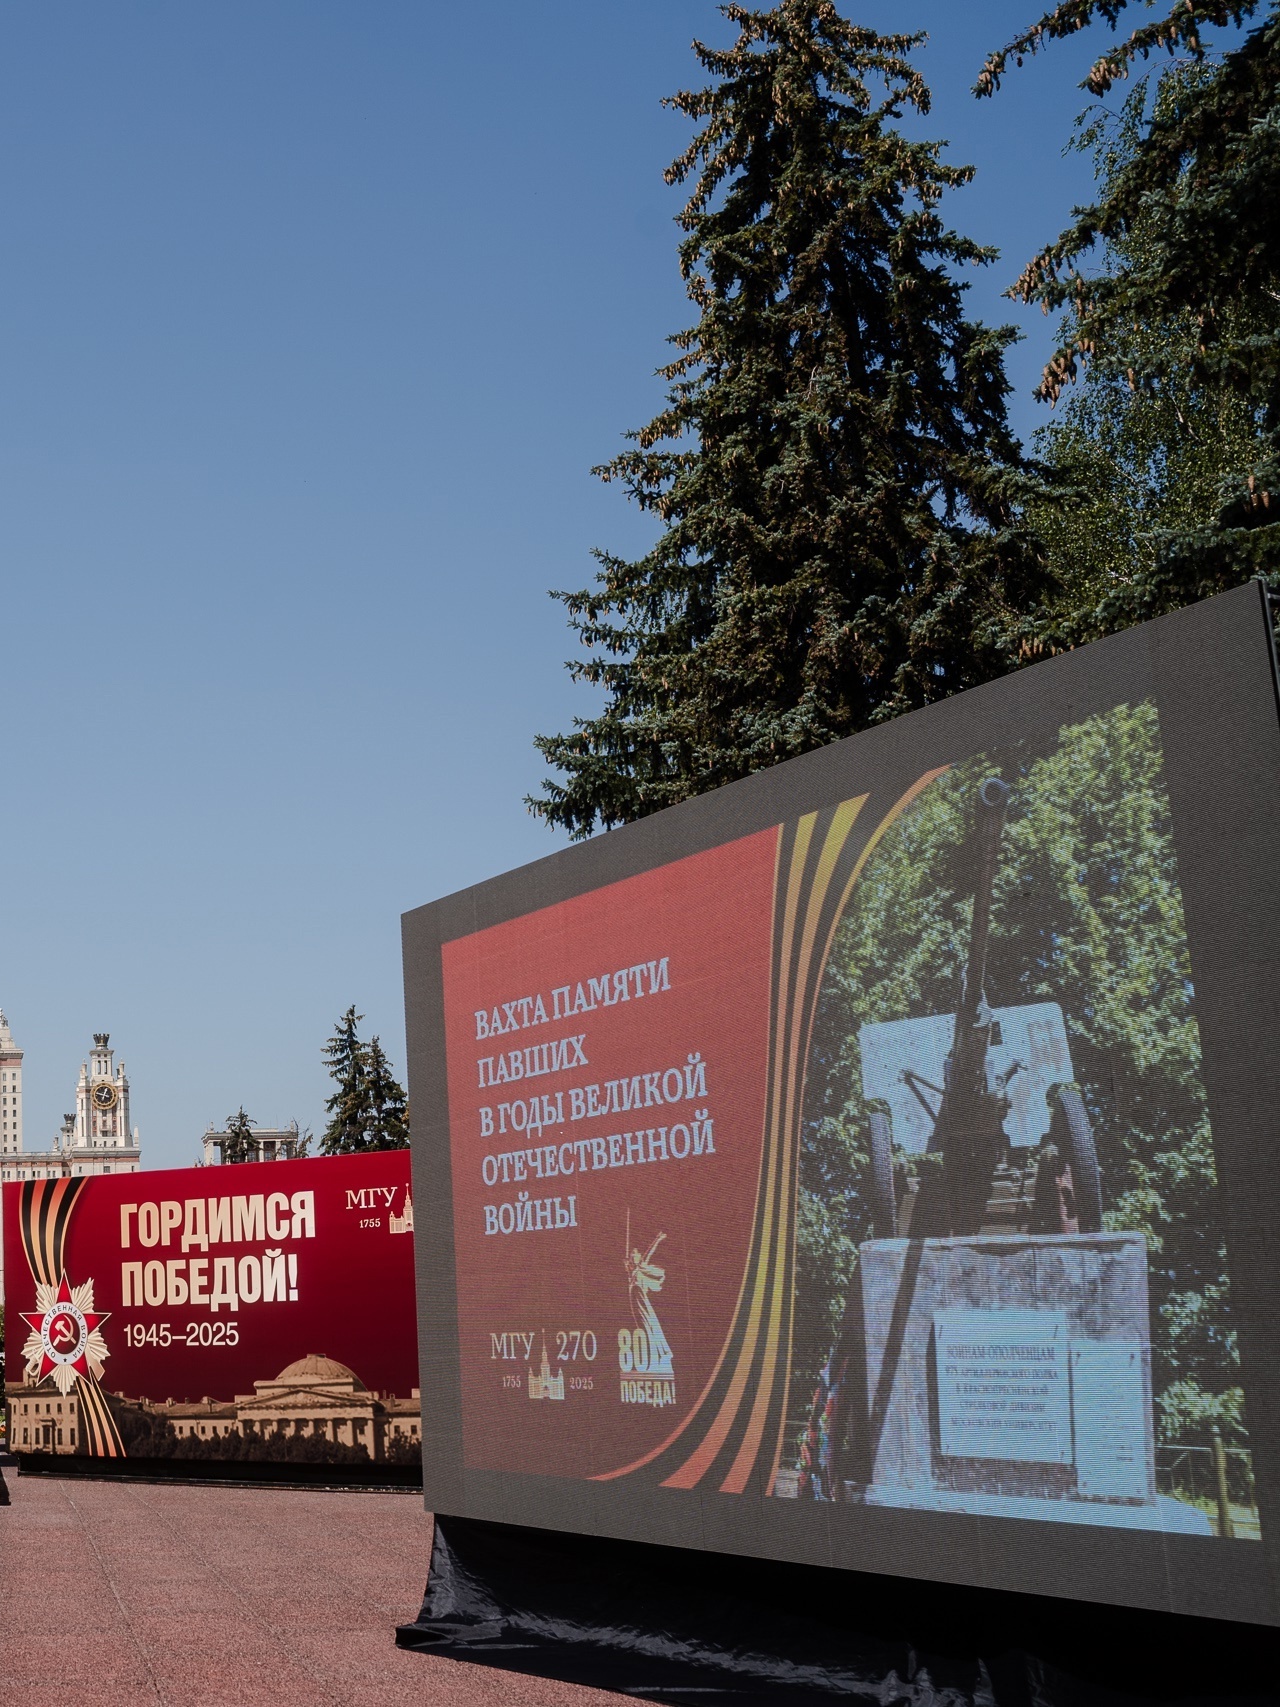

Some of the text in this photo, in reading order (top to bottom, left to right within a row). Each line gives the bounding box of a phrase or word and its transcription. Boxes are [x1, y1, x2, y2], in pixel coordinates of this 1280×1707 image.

[474, 957, 671, 1040] ВАХТА ПАМЯТИ
[477, 1034, 588, 1088] ПАВШИХ
[479, 1052, 708, 1138] В ГОДЫ ВЕЛИКОЙ
[481, 1109, 716, 1186] ОТЕЧЕСТВЕННОЙ
[120, 1191, 316, 1252] ГОРДИМСЯ
[345, 1186, 398, 1210] МГУ
[484, 1192, 578, 1235] ВОЙНЫ
[359, 1218, 381, 1229] 1755
[122, 1248, 299, 1312] ПОБЕДОЙ!
[43, 1305, 83, 1358] ОТЕЧЕСТВЕННАЯ
[490, 1330, 598, 1361] МГУ 270
[618, 1329, 648, 1373] 80
[503, 1375, 594, 1390] 1755 2025
[620, 1381, 677, 1408] ПОБЕДА!
